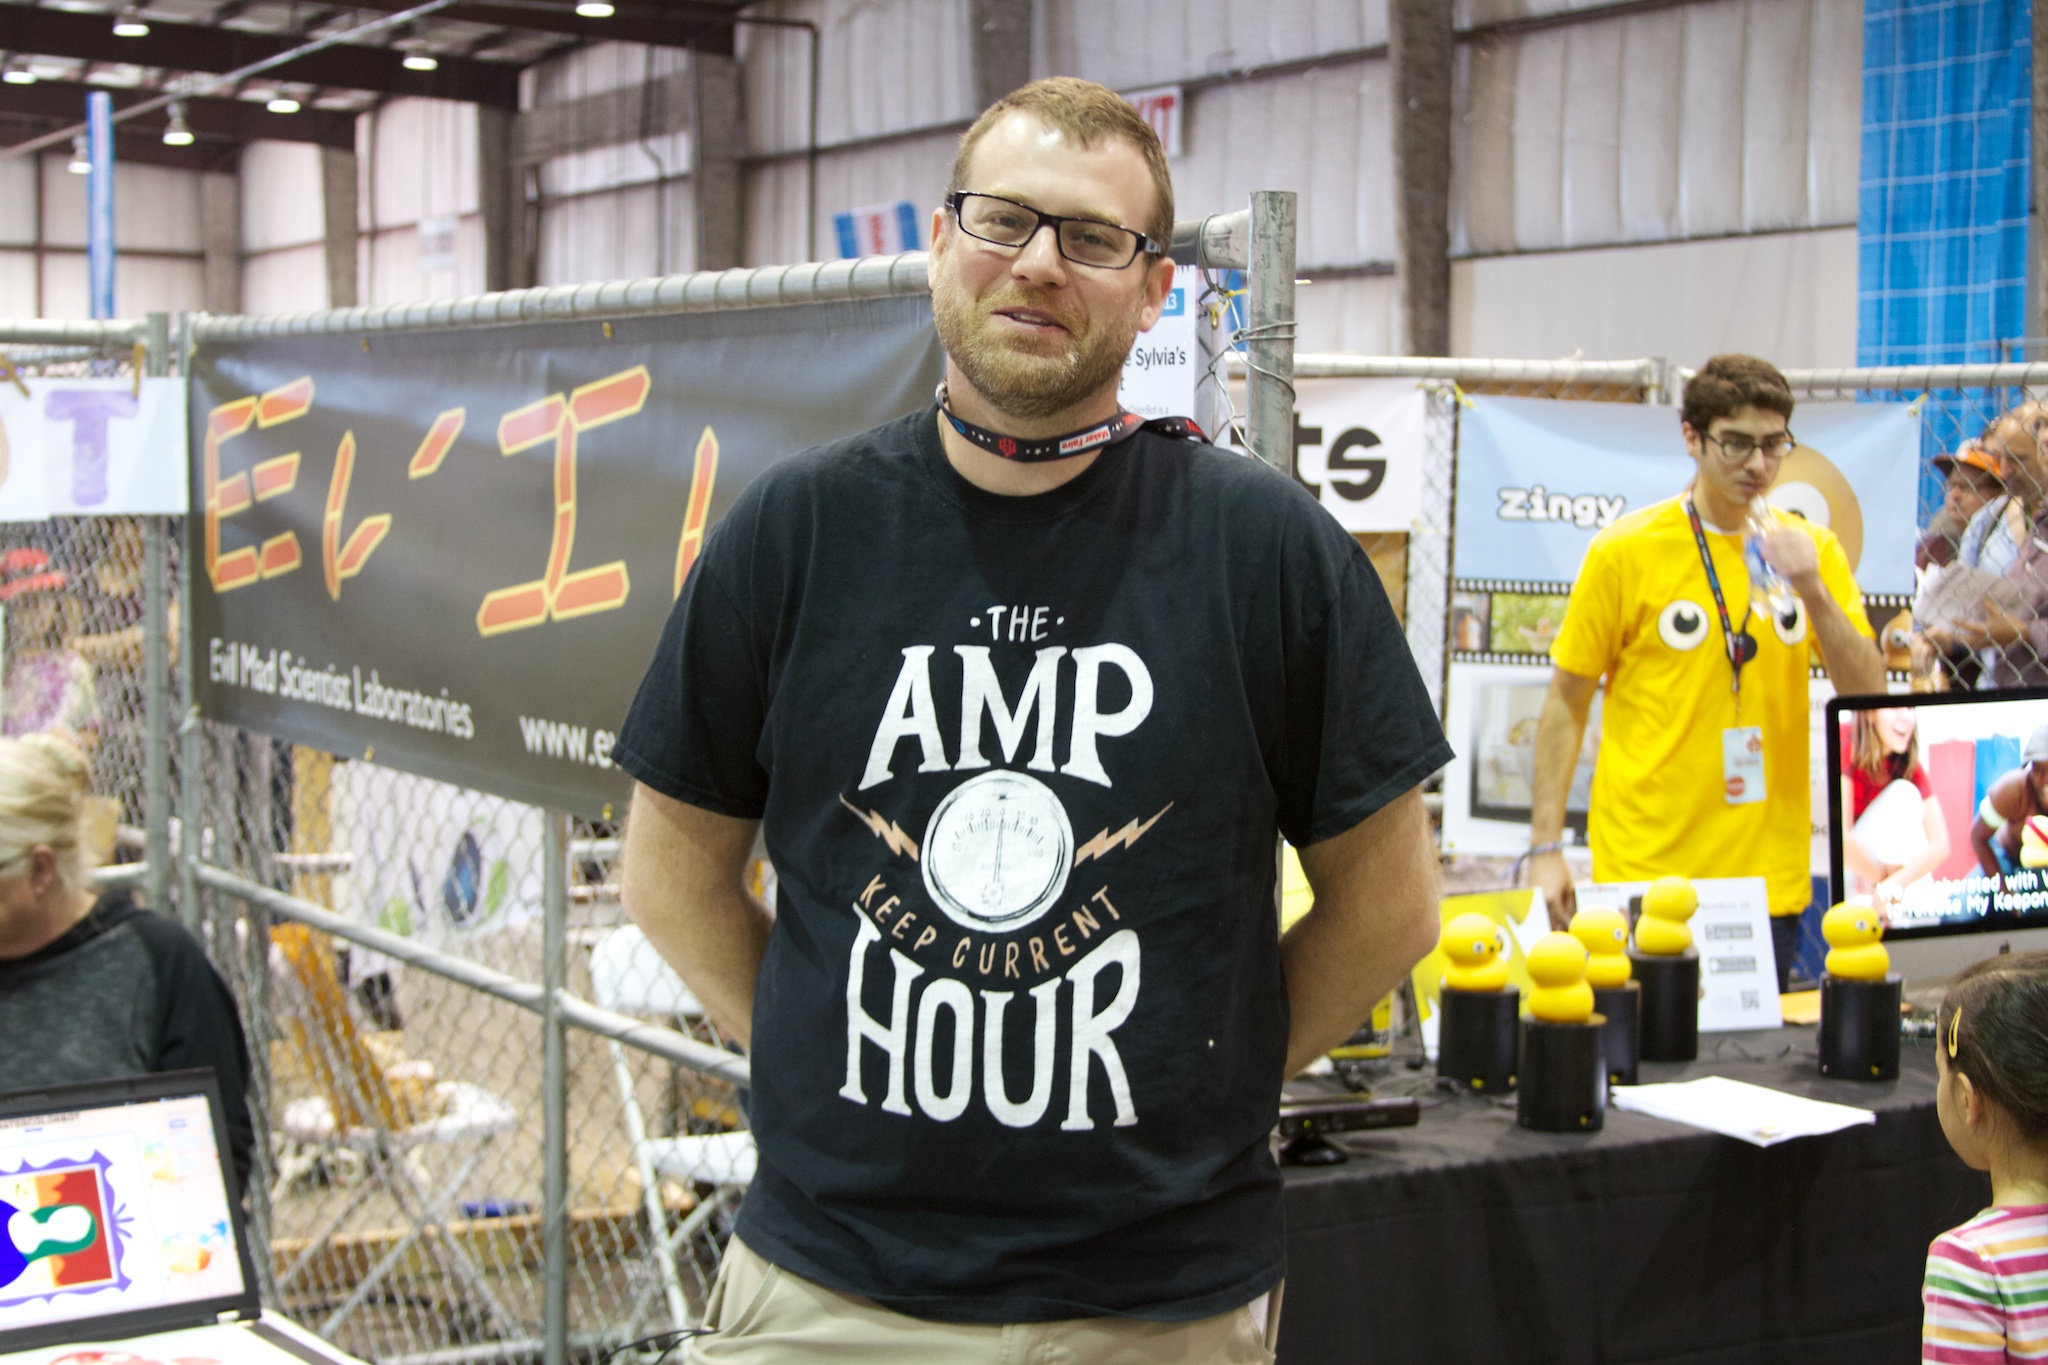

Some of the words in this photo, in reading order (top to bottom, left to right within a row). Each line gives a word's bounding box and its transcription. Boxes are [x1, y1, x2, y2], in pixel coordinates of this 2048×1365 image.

[1135, 346, 1186, 371] Sylvia's
[1126, 404, 1157, 415] ColorBot
[1061, 437, 1083, 449] Faire
[1085, 429, 1109, 442] Maker
[1293, 412, 1387, 502] ts
[1497, 485, 1625, 529] Zingy
[986, 605, 1049, 642] THE
[210, 637, 238, 685] Evil
[240, 642, 277, 694] Mad
[279, 650, 352, 712] Scientist
[352, 665, 475, 740] Laboratories
[858, 641, 1154, 791] AMP
[2005, 869, 2038, 891] with
[1966, 893, 1989, 916] My
[859, 873, 937, 952] KEEP
[952, 885, 1121, 979] CURRENT
[838, 902, 1141, 1131] HOUR
